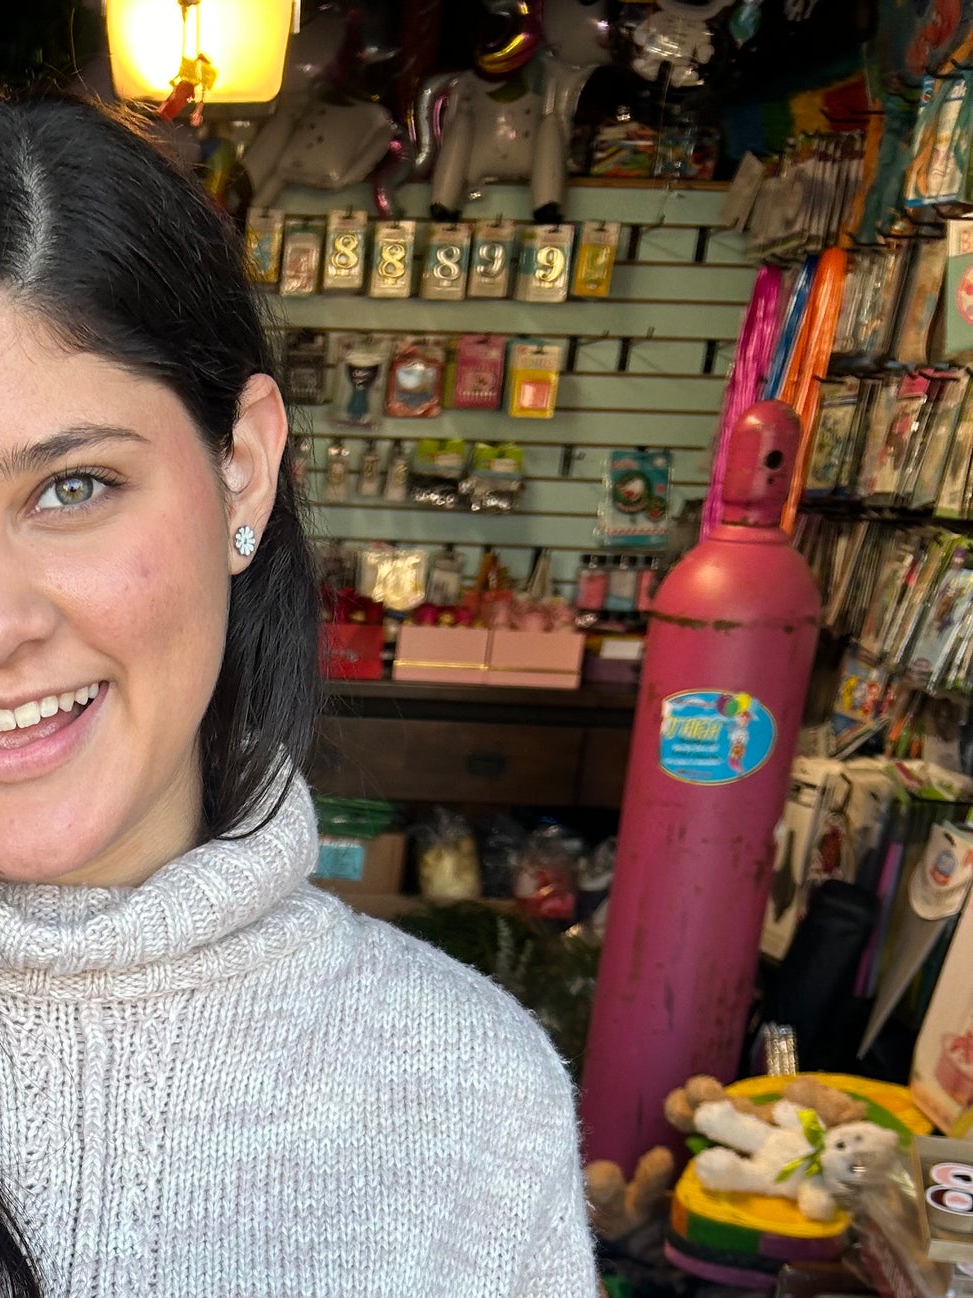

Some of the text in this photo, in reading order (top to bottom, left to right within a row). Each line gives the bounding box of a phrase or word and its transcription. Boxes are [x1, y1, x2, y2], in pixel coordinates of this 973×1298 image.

[331, 234, 359, 270] 8
[378, 243, 406, 278] 8
[433, 246, 461, 281] 8
[477, 242, 504, 278] 9
[535, 246, 566, 282] 9
